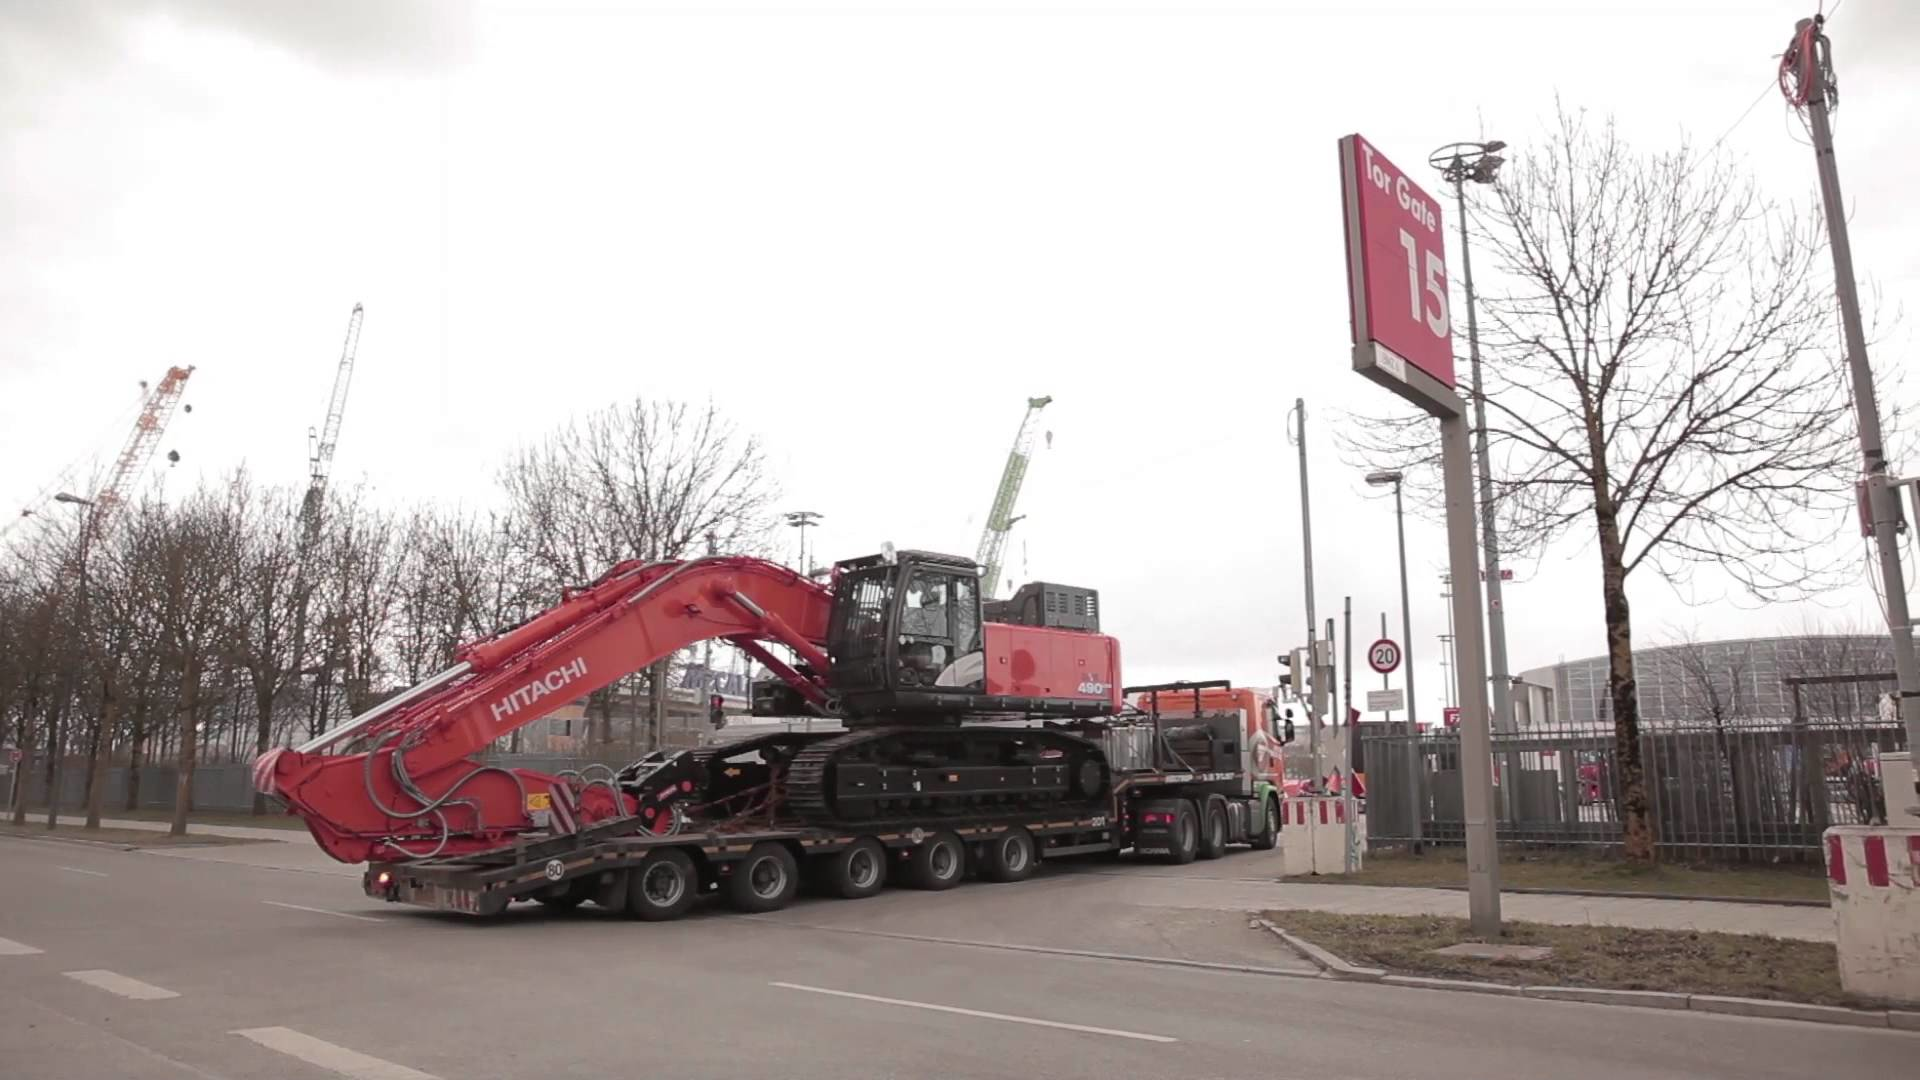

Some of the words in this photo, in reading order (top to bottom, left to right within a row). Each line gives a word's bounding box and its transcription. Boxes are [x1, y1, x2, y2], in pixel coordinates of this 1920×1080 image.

[1361, 145, 1391, 195] Tor
[1396, 176, 1436, 233] Gate
[1400, 228, 1449, 339] 15
[1375, 648, 1394, 664] 20
[490, 656, 588, 722] HITACHI
[1077, 682, 1103, 694] 490
[548, 863, 562, 877] 80
